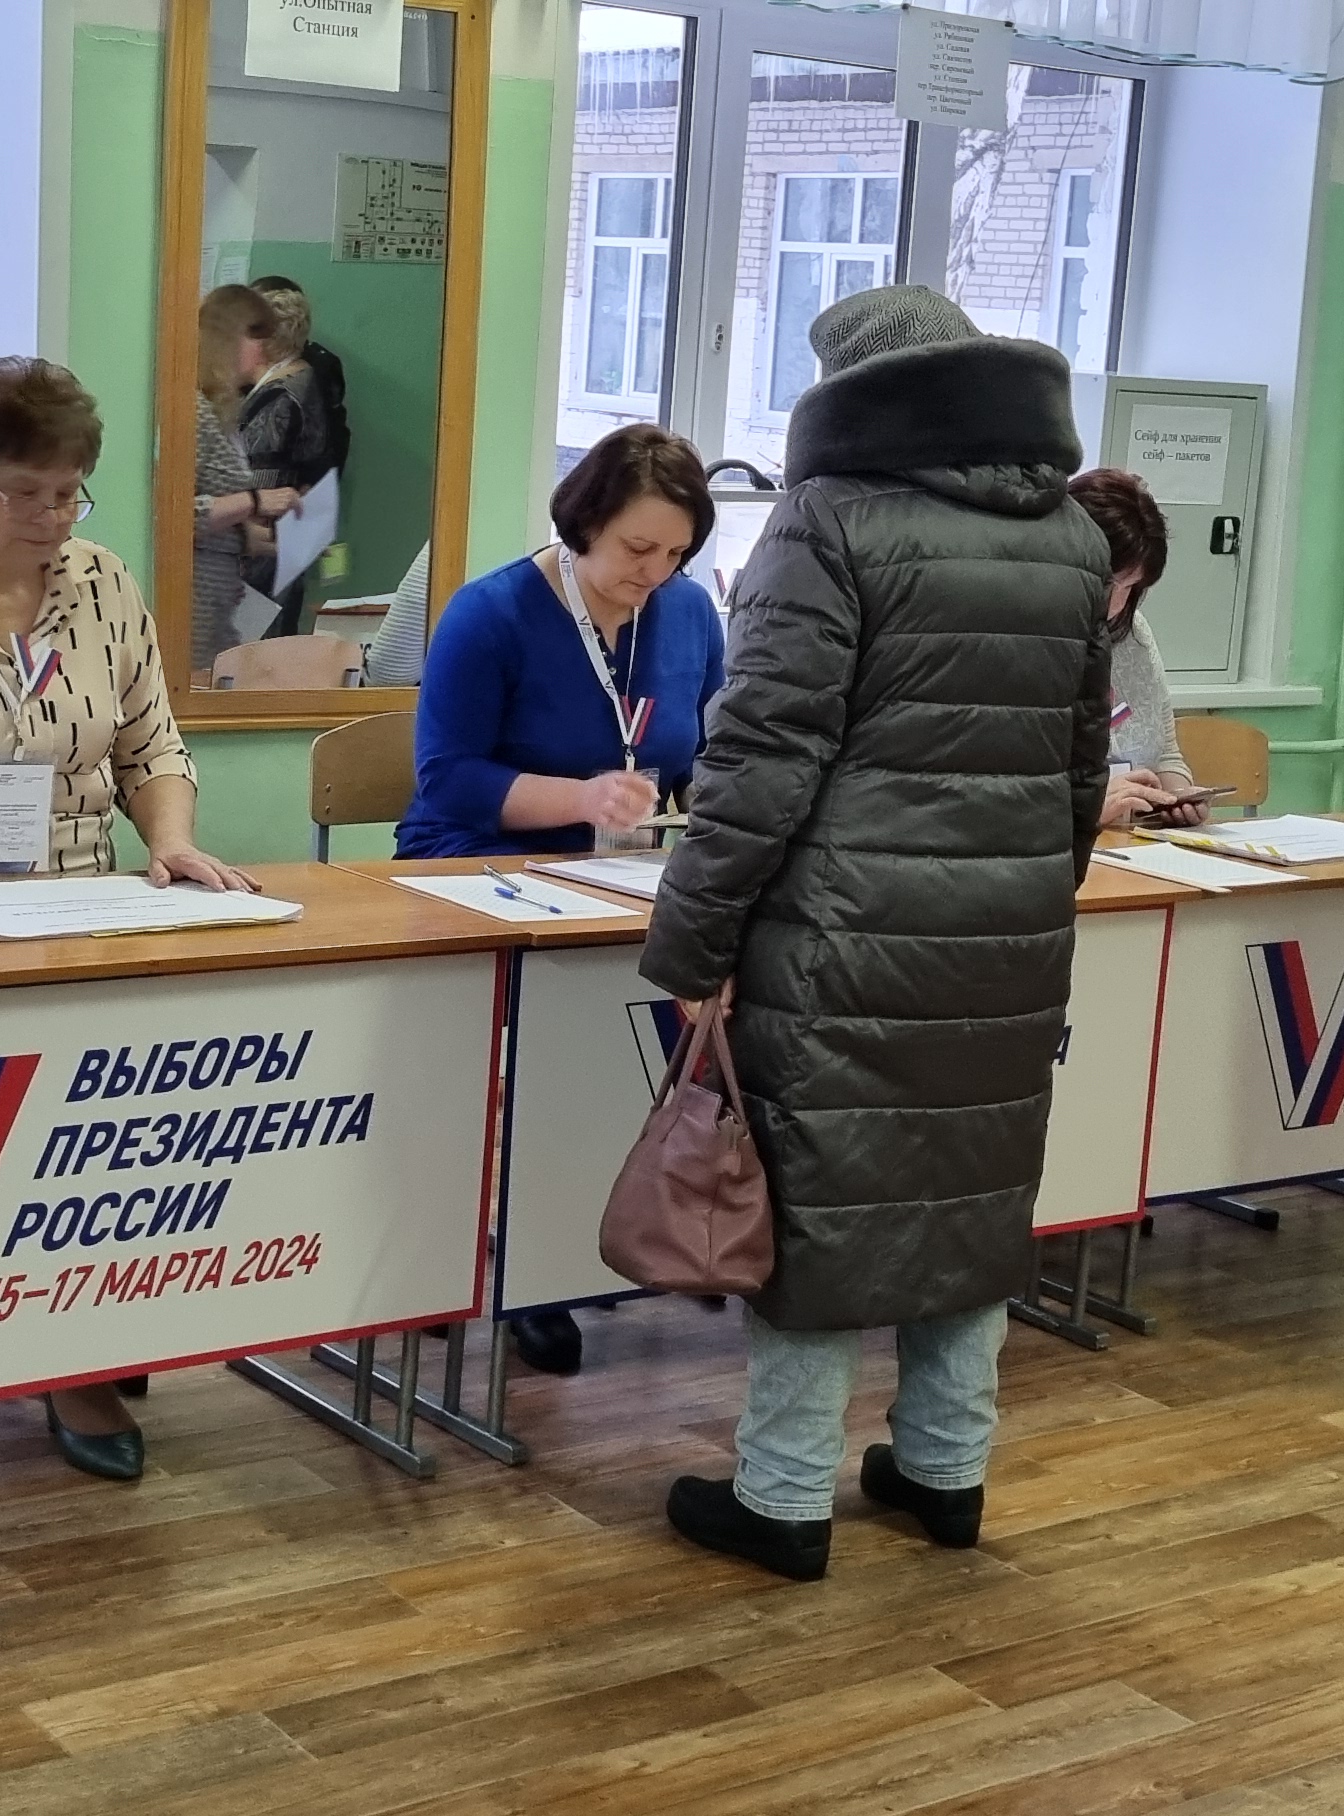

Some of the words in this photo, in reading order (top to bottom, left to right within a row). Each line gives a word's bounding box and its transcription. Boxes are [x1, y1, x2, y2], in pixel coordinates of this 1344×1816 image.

[292, 16, 360, 39] Станция
[1134, 429, 1160, 445] Сейф
[1160, 433, 1178, 444] для
[1179, 434, 1222, 446] хранения
[1142, 449, 1165, 463] сейф
[1175, 452, 1211, 462] пакетов
[64, 1029, 314, 1103] ВЫБОРЫ
[32, 1093, 376, 1181] ПРЕЗИДЕНТА
[1, 1179, 232, 1258] РОССИИ
[93, 1246, 228, 1308] МАРТА
[229, 1233, 323, 1288] 2024
